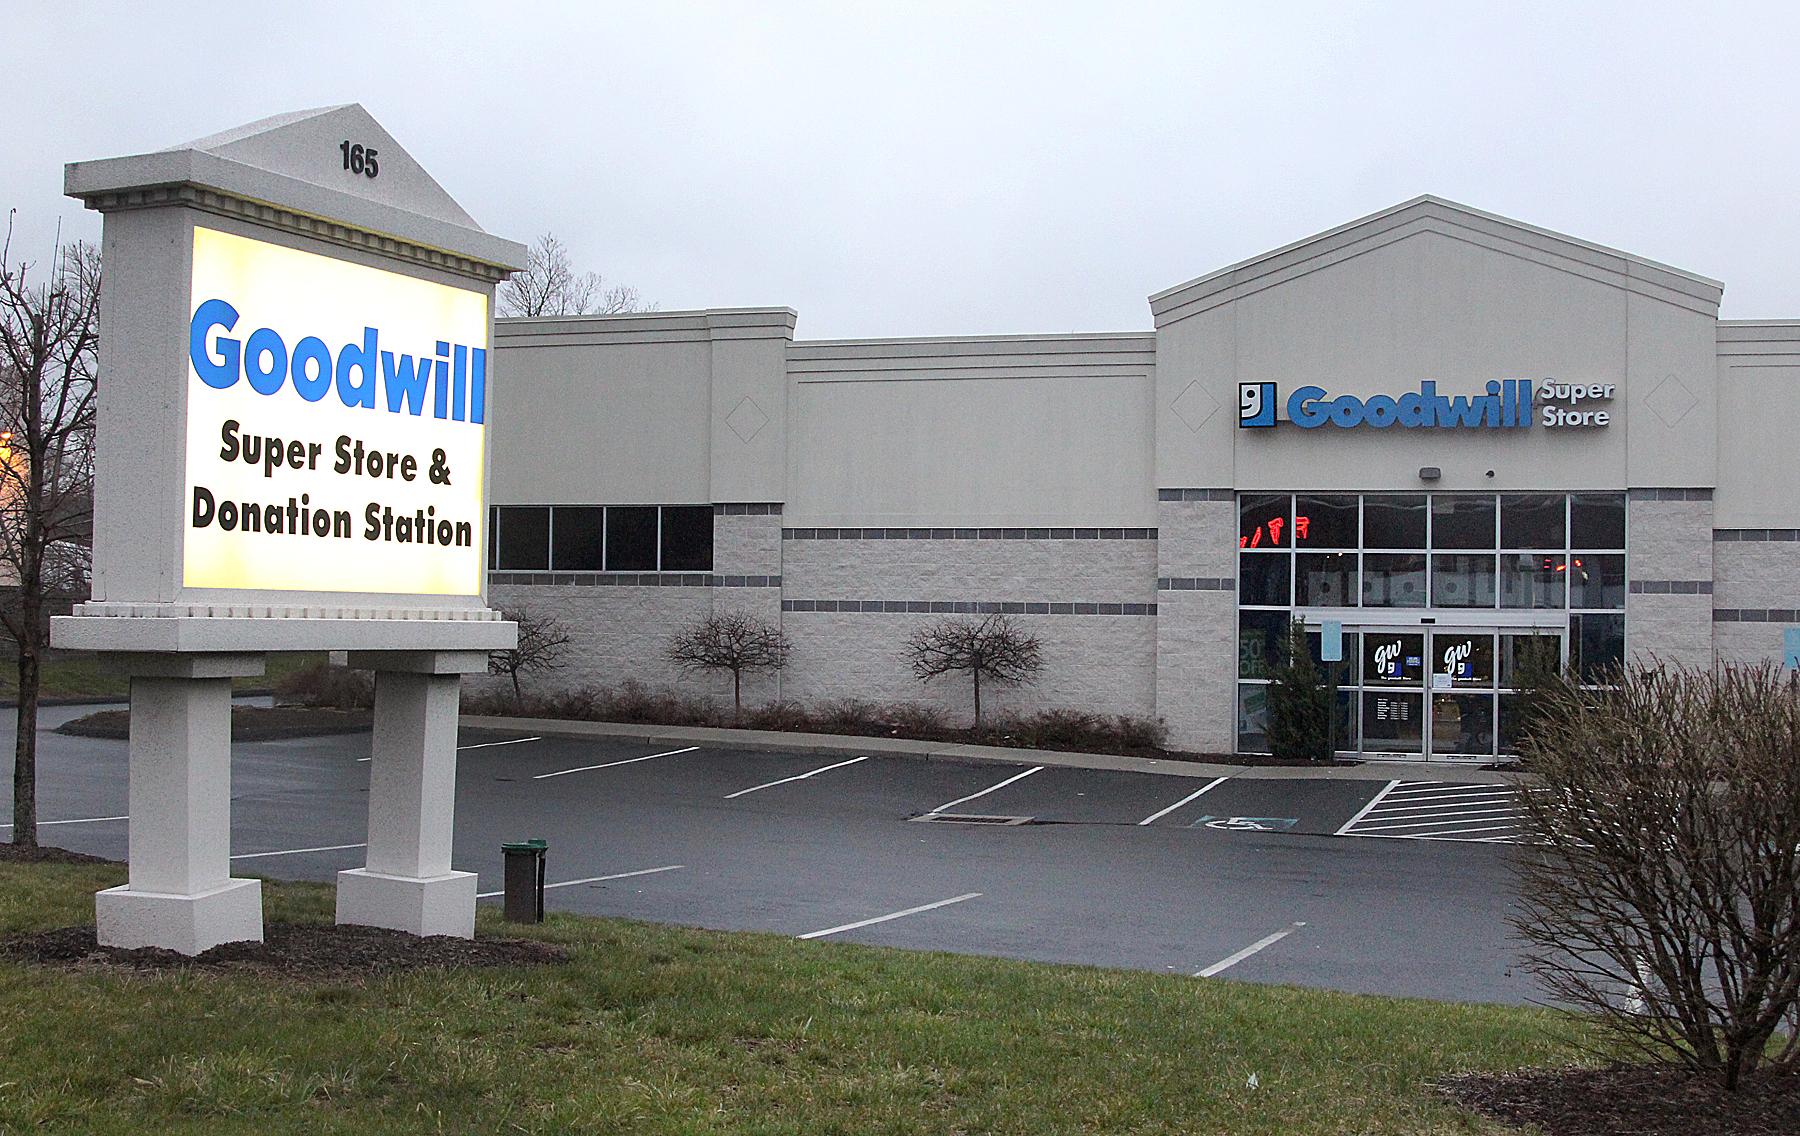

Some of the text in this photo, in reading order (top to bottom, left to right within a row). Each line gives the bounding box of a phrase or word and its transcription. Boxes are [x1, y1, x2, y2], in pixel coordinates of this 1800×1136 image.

[340, 140, 379, 178] 165
[190, 299, 486, 424] Goodwill
[1286, 379, 1533, 429] Goodwill
[1540, 378, 1616, 404] Super
[1541, 405, 1611, 427] Store
[220, 419, 451, 485] Super Store &
[193, 486, 471, 546] Donation Station
